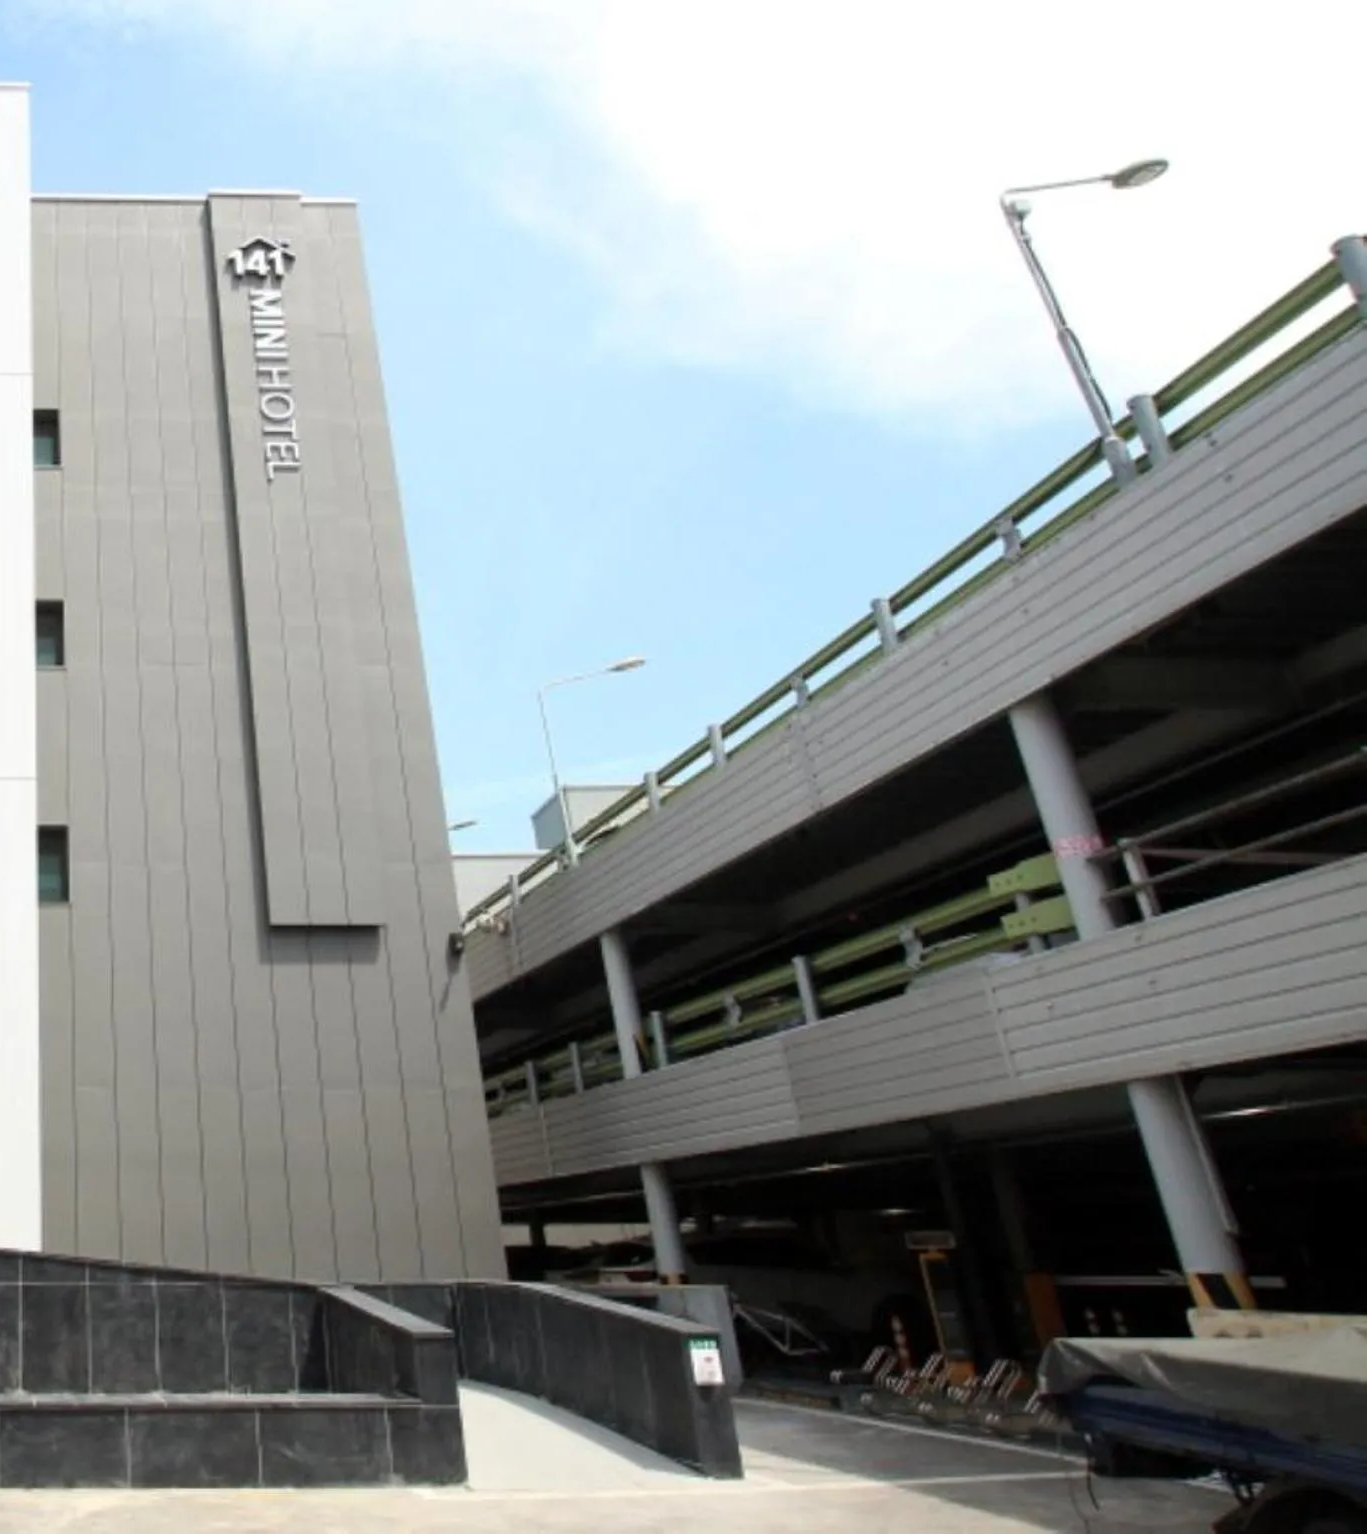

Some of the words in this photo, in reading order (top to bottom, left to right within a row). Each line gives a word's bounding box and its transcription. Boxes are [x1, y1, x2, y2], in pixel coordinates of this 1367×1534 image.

[228, 248, 285, 276] 141
[249, 288, 290, 358] MINI
[257, 366, 302, 480] HOTEL
